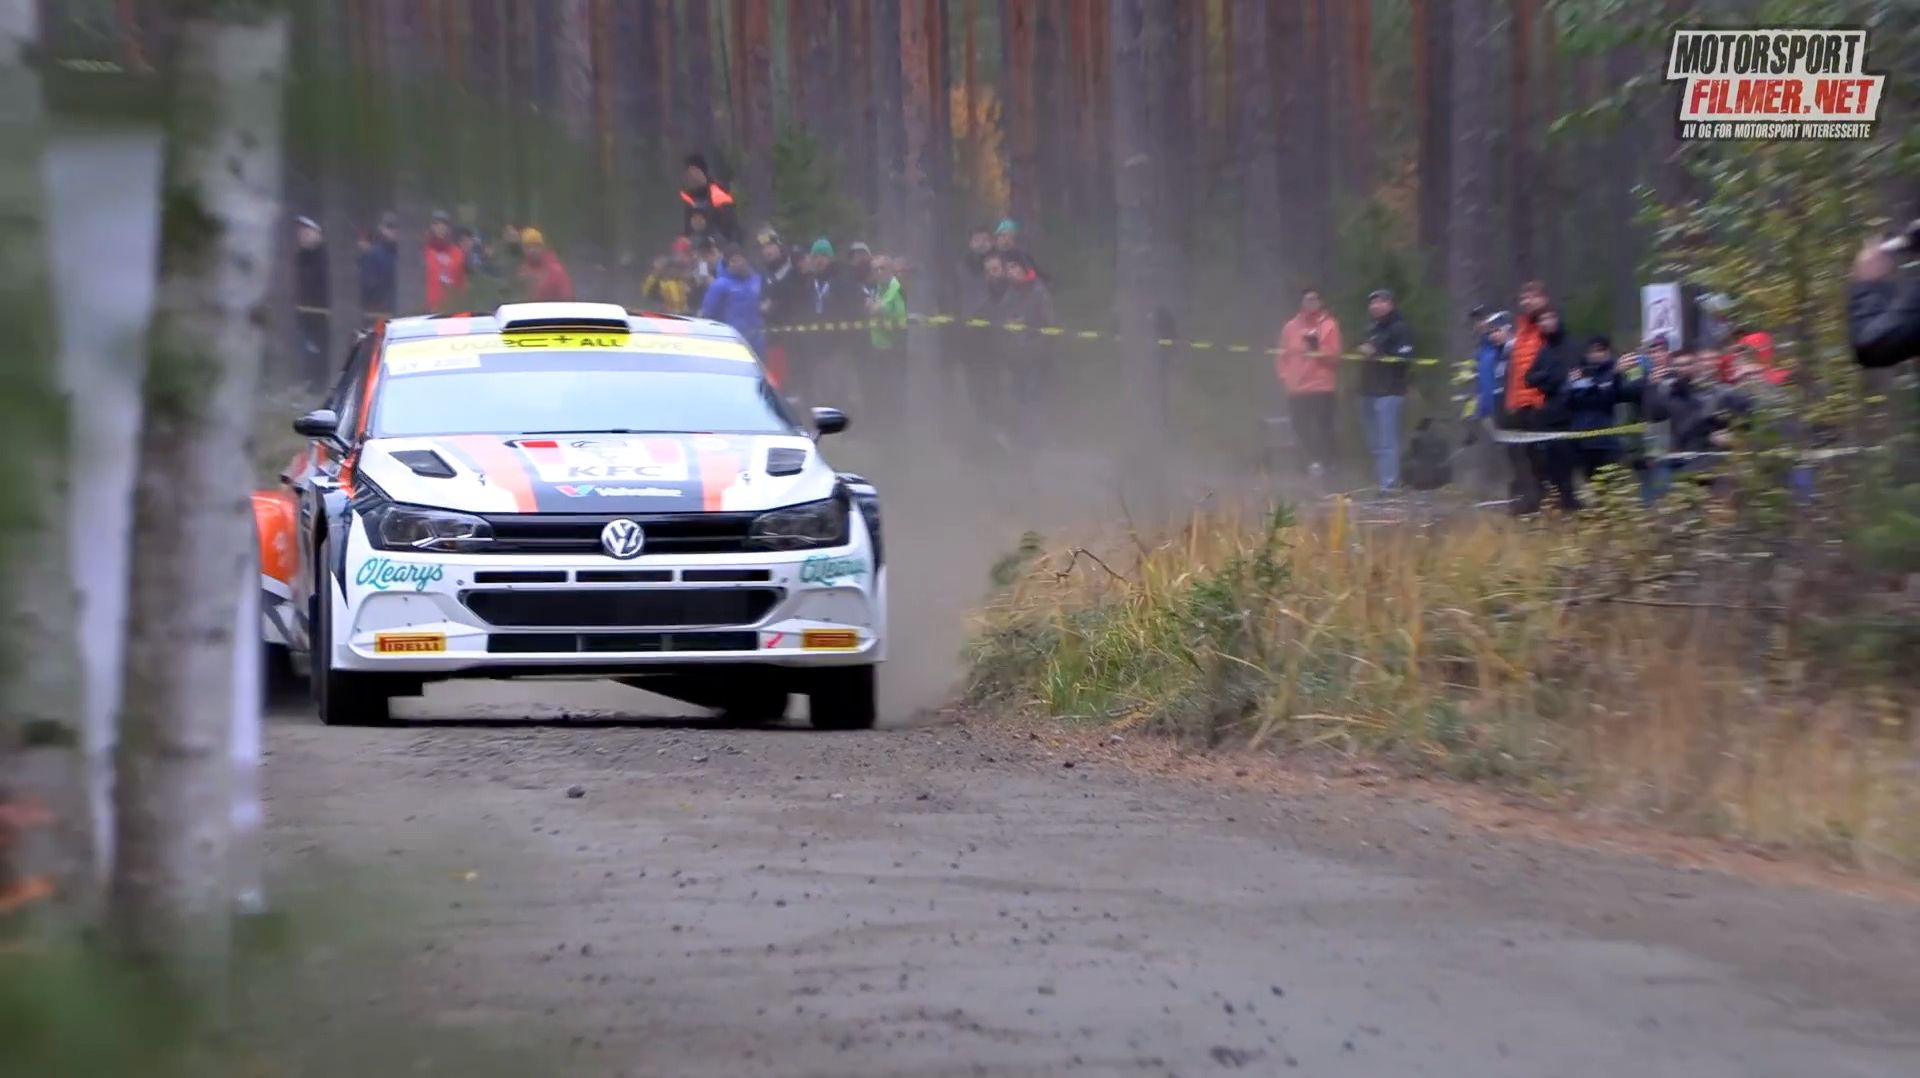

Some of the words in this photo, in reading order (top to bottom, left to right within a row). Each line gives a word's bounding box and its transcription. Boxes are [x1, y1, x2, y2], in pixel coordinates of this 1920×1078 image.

[580, 337, 624, 349] ALL
[567, 465, 663, 478] KFC
[379, 636, 441, 652] PIRELLI
